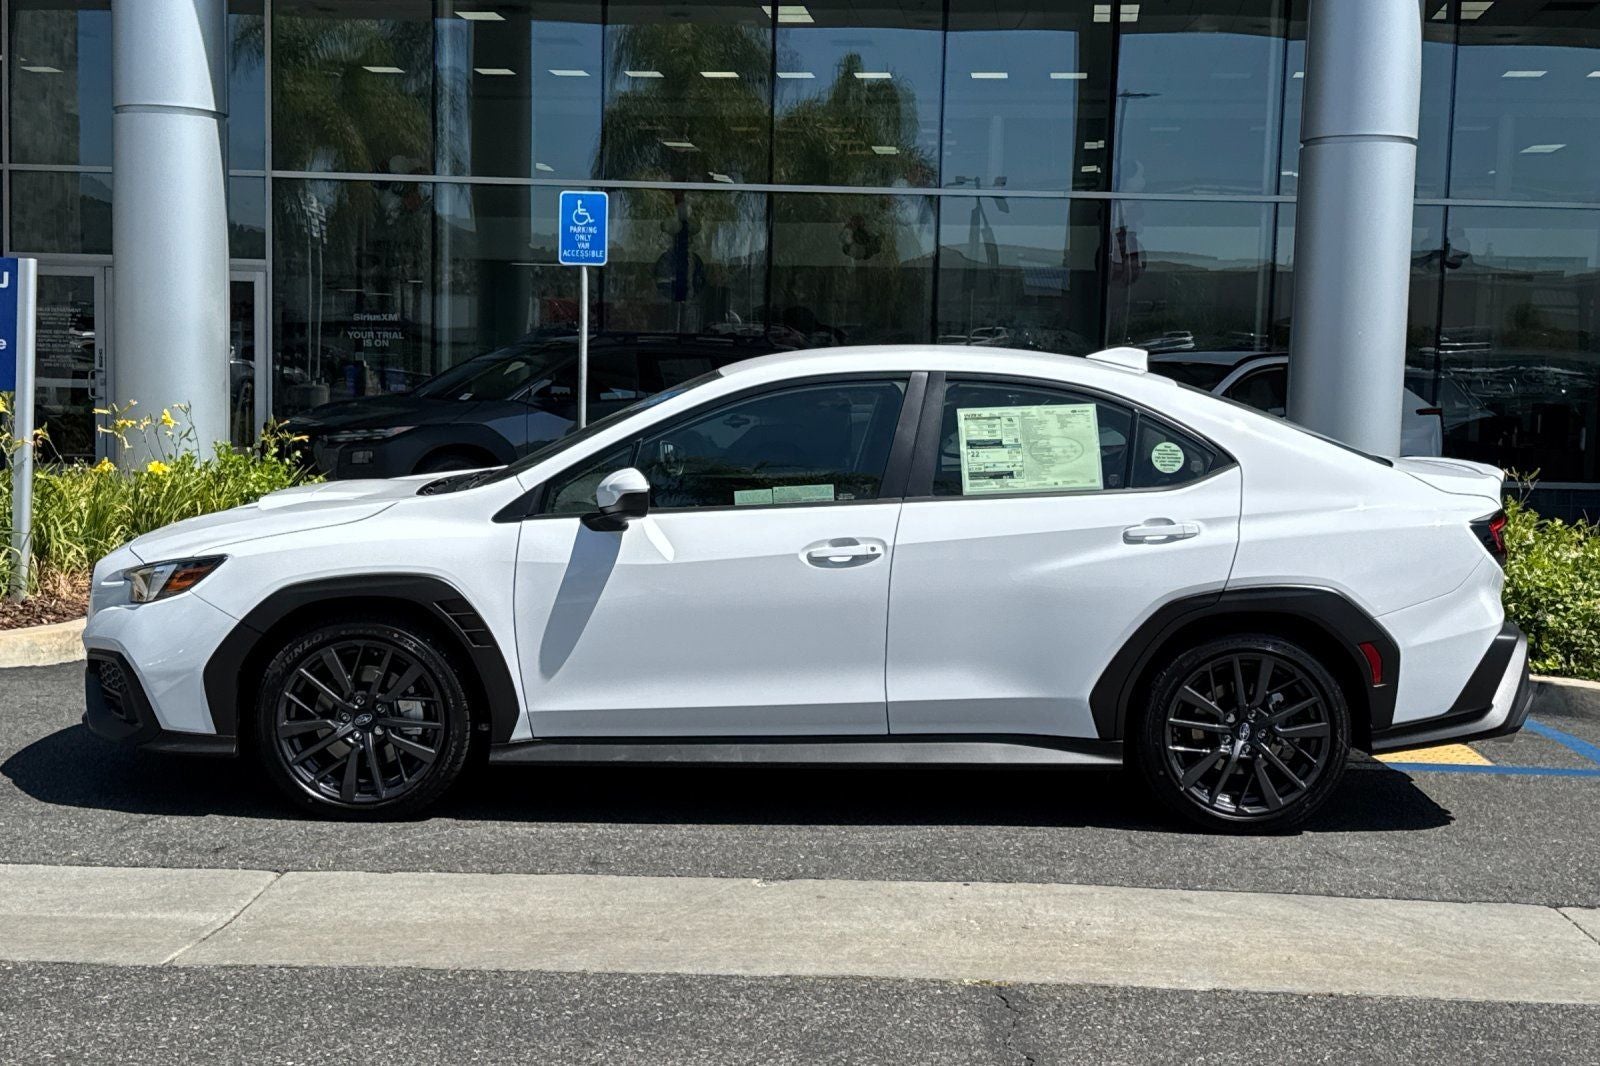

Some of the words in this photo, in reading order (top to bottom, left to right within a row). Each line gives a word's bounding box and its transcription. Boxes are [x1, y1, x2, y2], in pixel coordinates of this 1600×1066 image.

[570, 226, 598, 234] PARKING
[575, 234, 592, 242] ONLY
[563, 249, 604, 258] ACCESSIBLE
[352, 313, 398, 321] SiriusXM
[347, 331, 374, 339] YOUR
[375, 331, 405, 339] TRIAL
[363, 339, 373, 347] IS
[374, 339, 389, 347] ON
